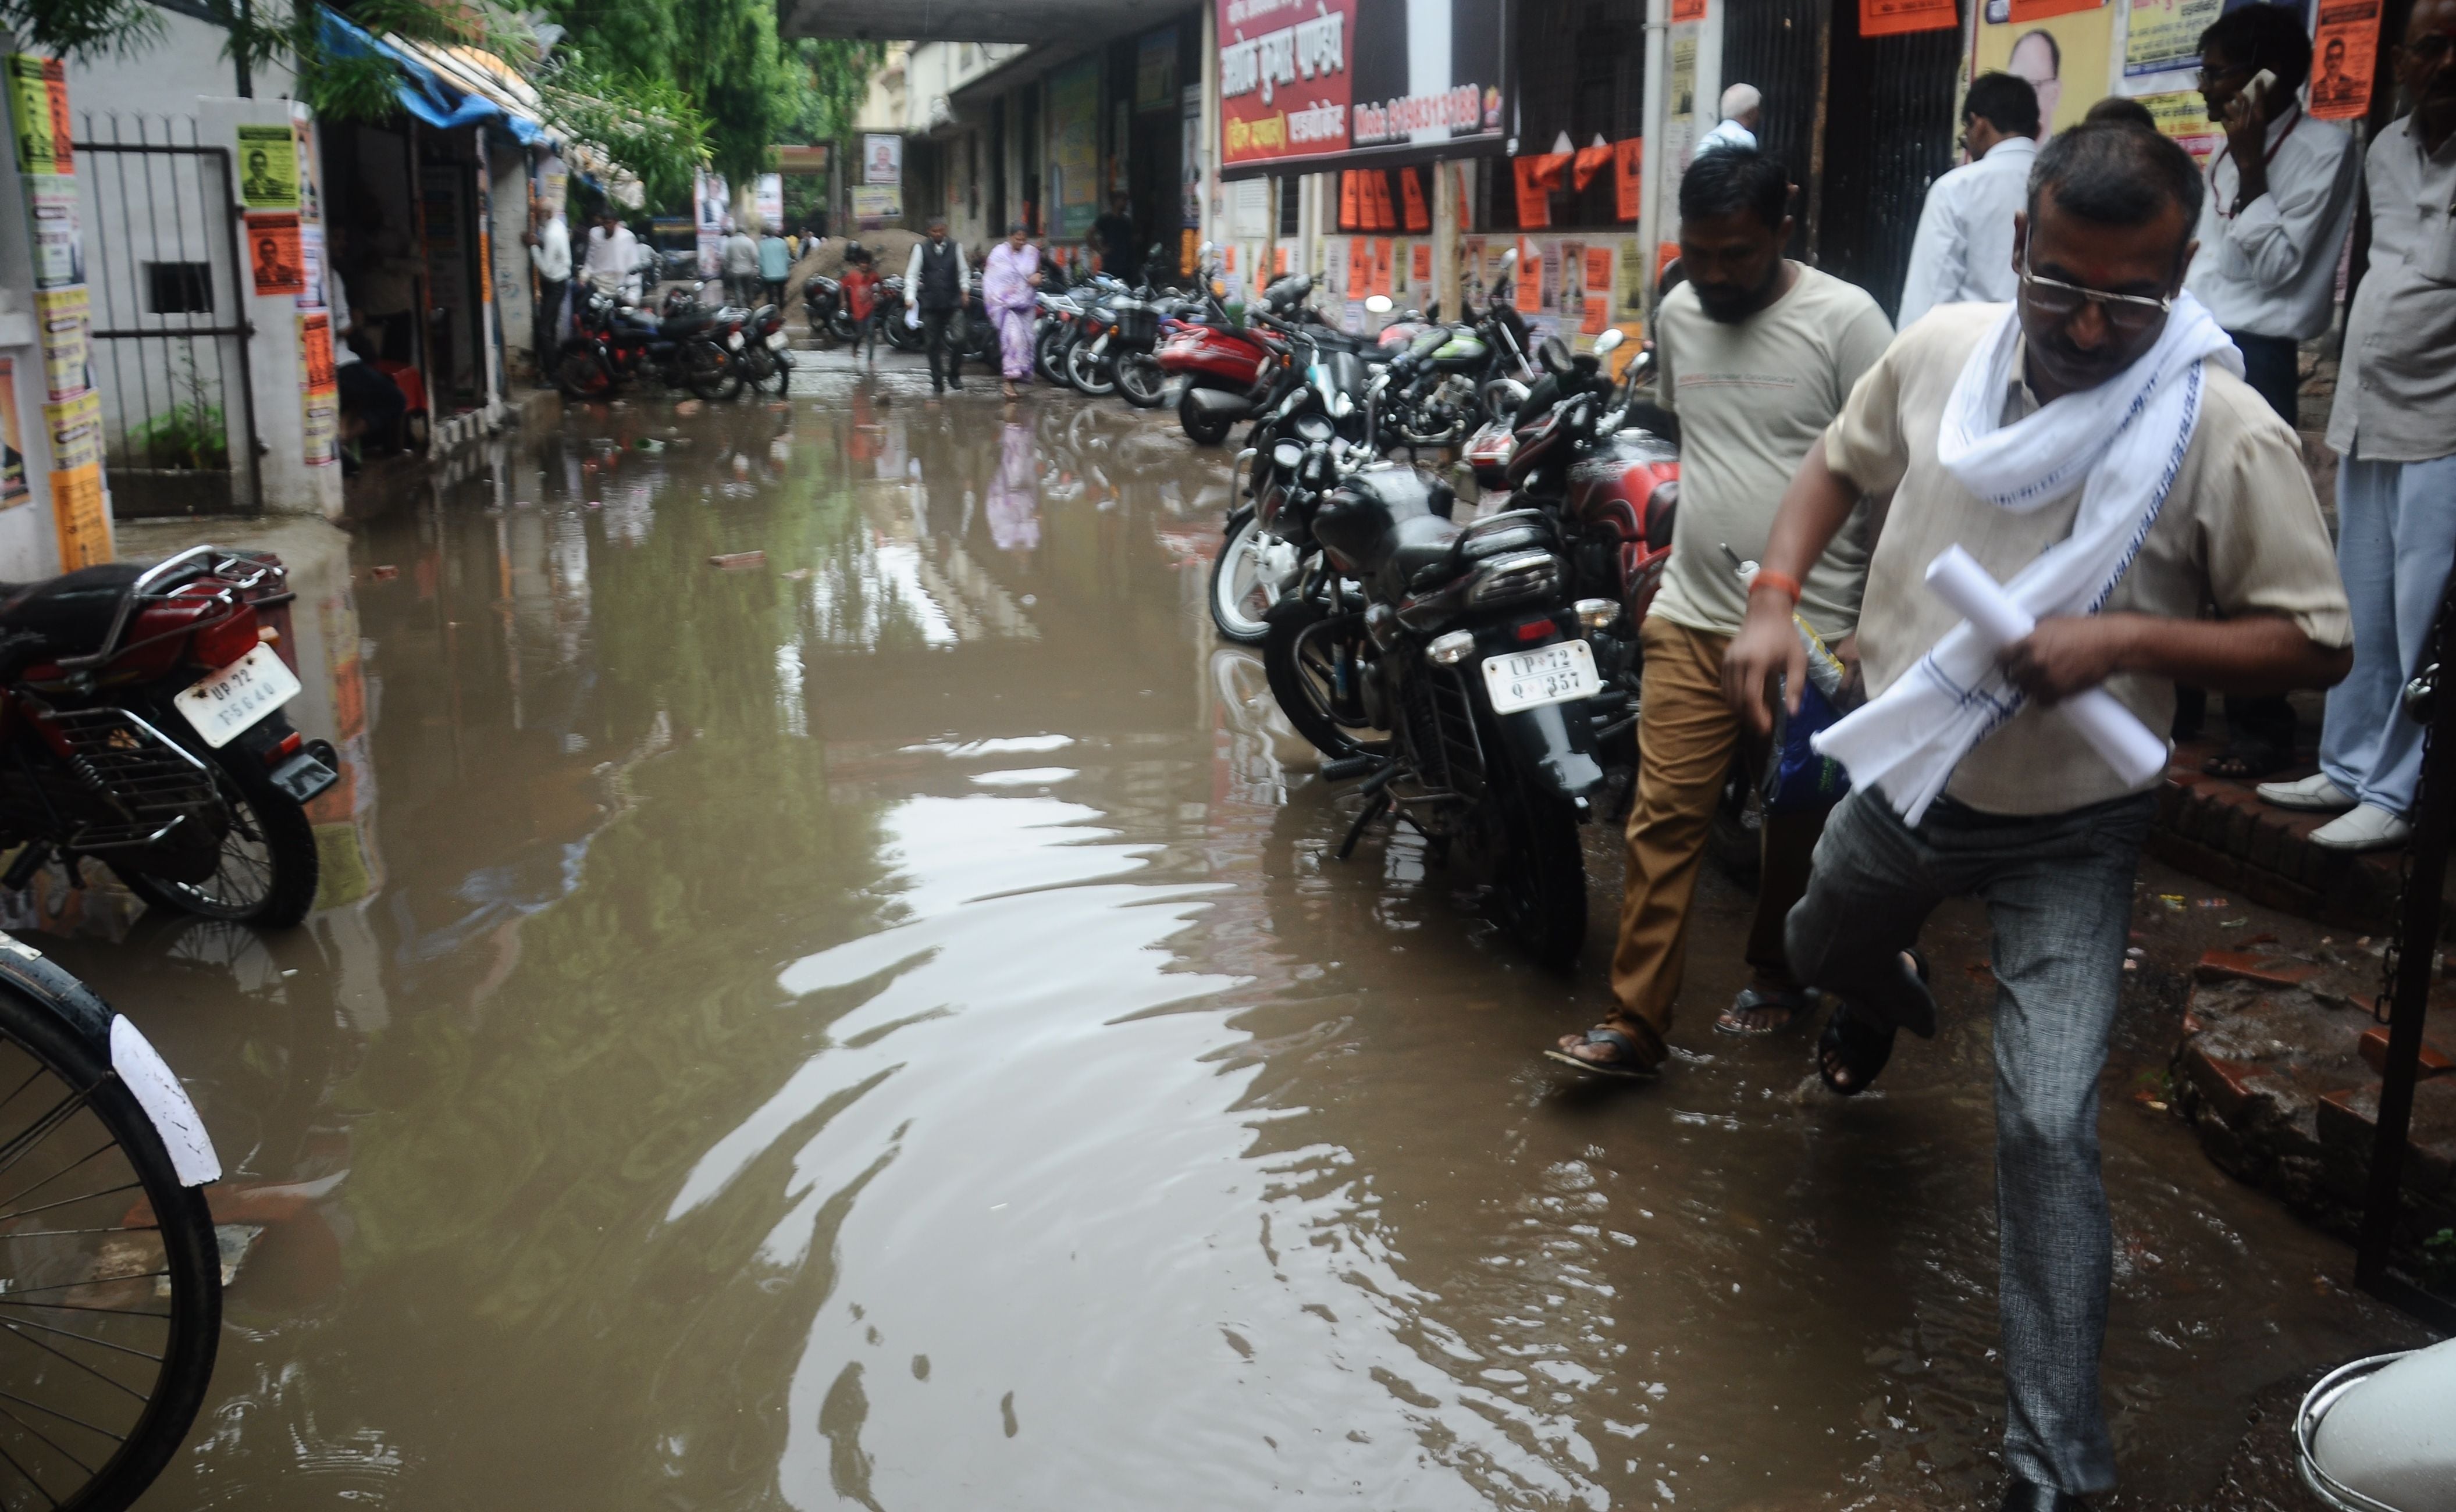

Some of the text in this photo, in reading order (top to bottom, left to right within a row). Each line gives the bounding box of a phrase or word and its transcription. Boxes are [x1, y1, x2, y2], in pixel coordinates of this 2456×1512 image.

[1258, 25, 1295, 106] कुमार
[1510, 649, 1571, 675] UP 72
